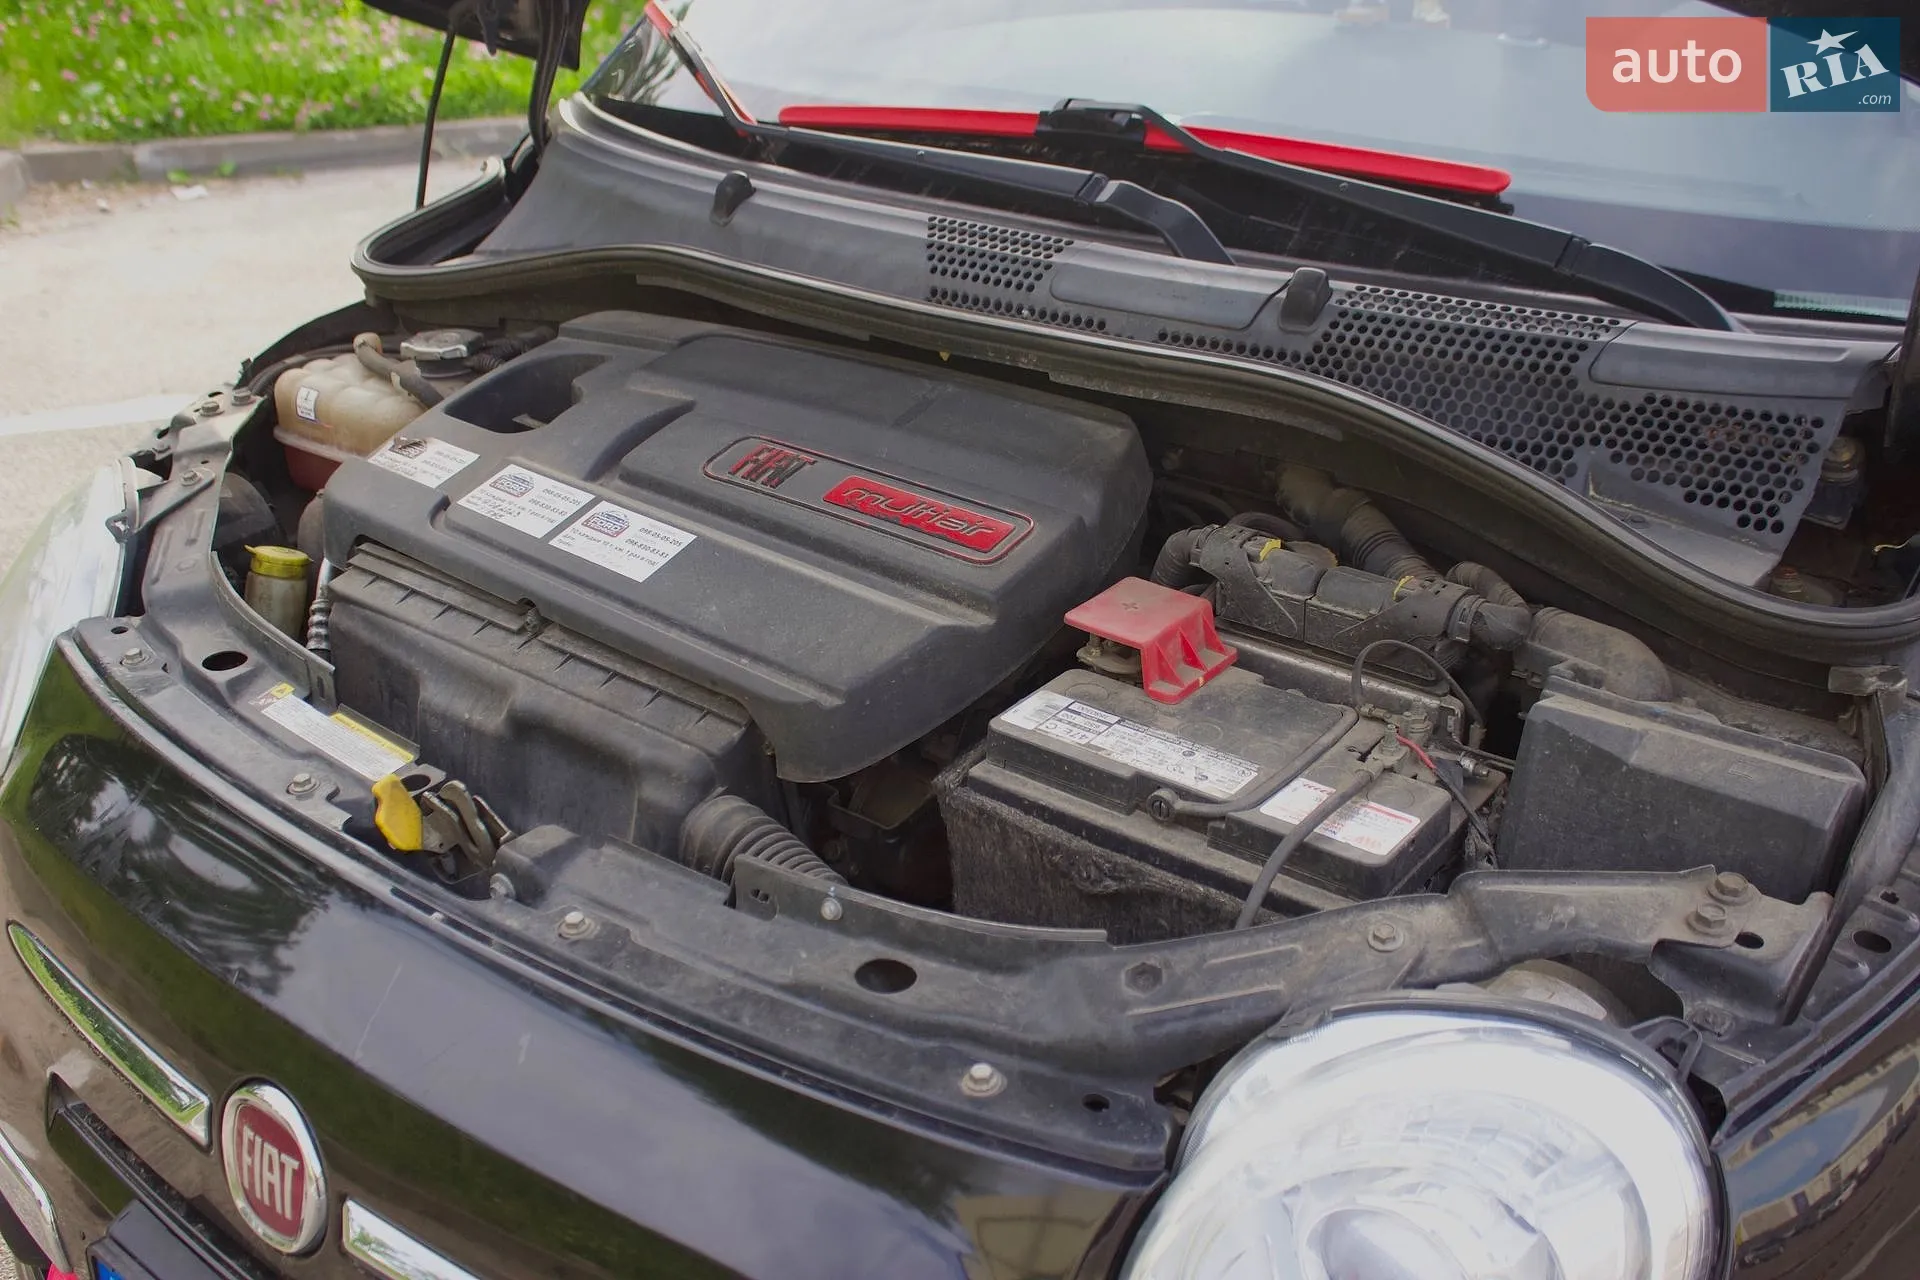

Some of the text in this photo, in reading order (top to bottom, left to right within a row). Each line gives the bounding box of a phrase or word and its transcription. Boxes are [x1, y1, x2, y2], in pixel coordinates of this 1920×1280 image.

[728, 443, 818, 489] FIAT
[842, 487, 996, 536] multiair
[242, 1125, 300, 1220] FIAT
